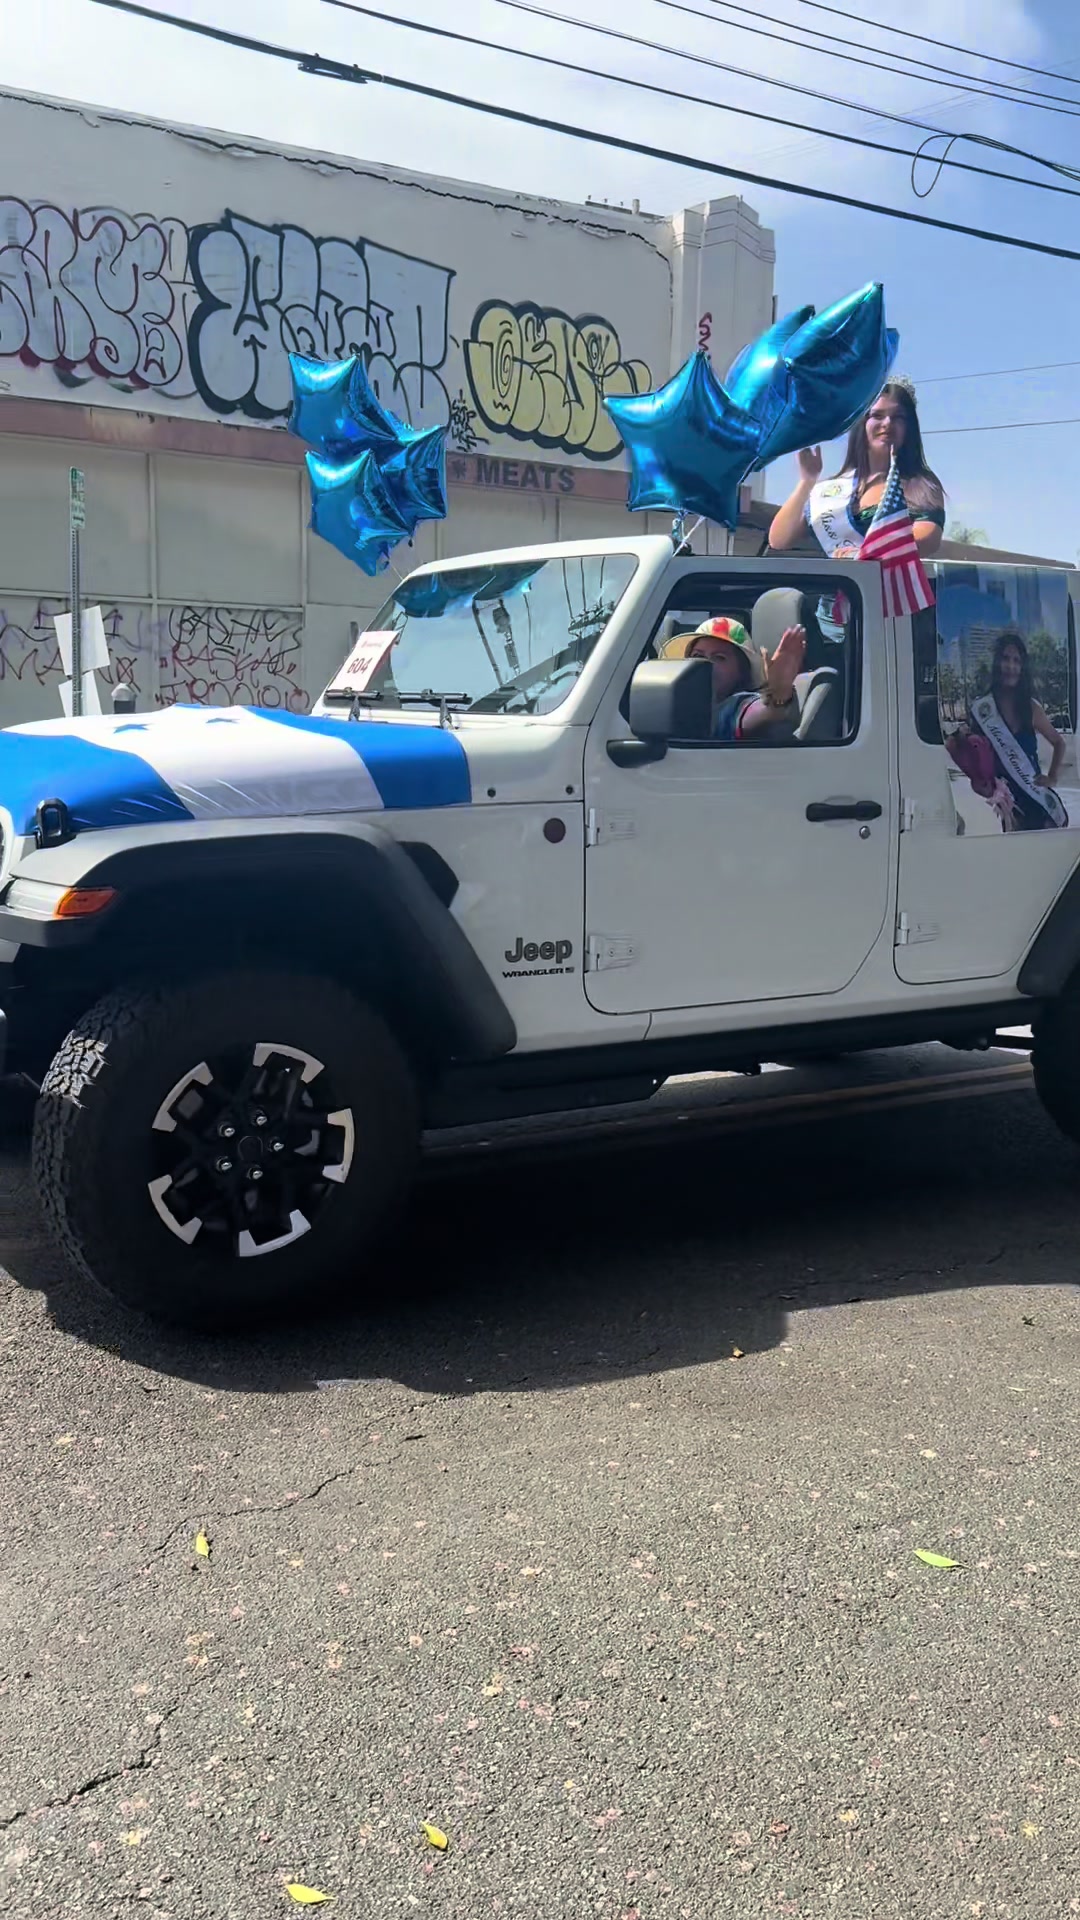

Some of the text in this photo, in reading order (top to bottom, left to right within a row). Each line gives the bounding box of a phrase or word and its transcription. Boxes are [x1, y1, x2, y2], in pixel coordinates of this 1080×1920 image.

[477, 457, 575, 492] MEATS
[347, 657, 373, 674] 604
[988, 725, 1006, 747] Miss
[505, 937, 573, 964] Jeep
[502, 967, 564, 978] WRANGLER
